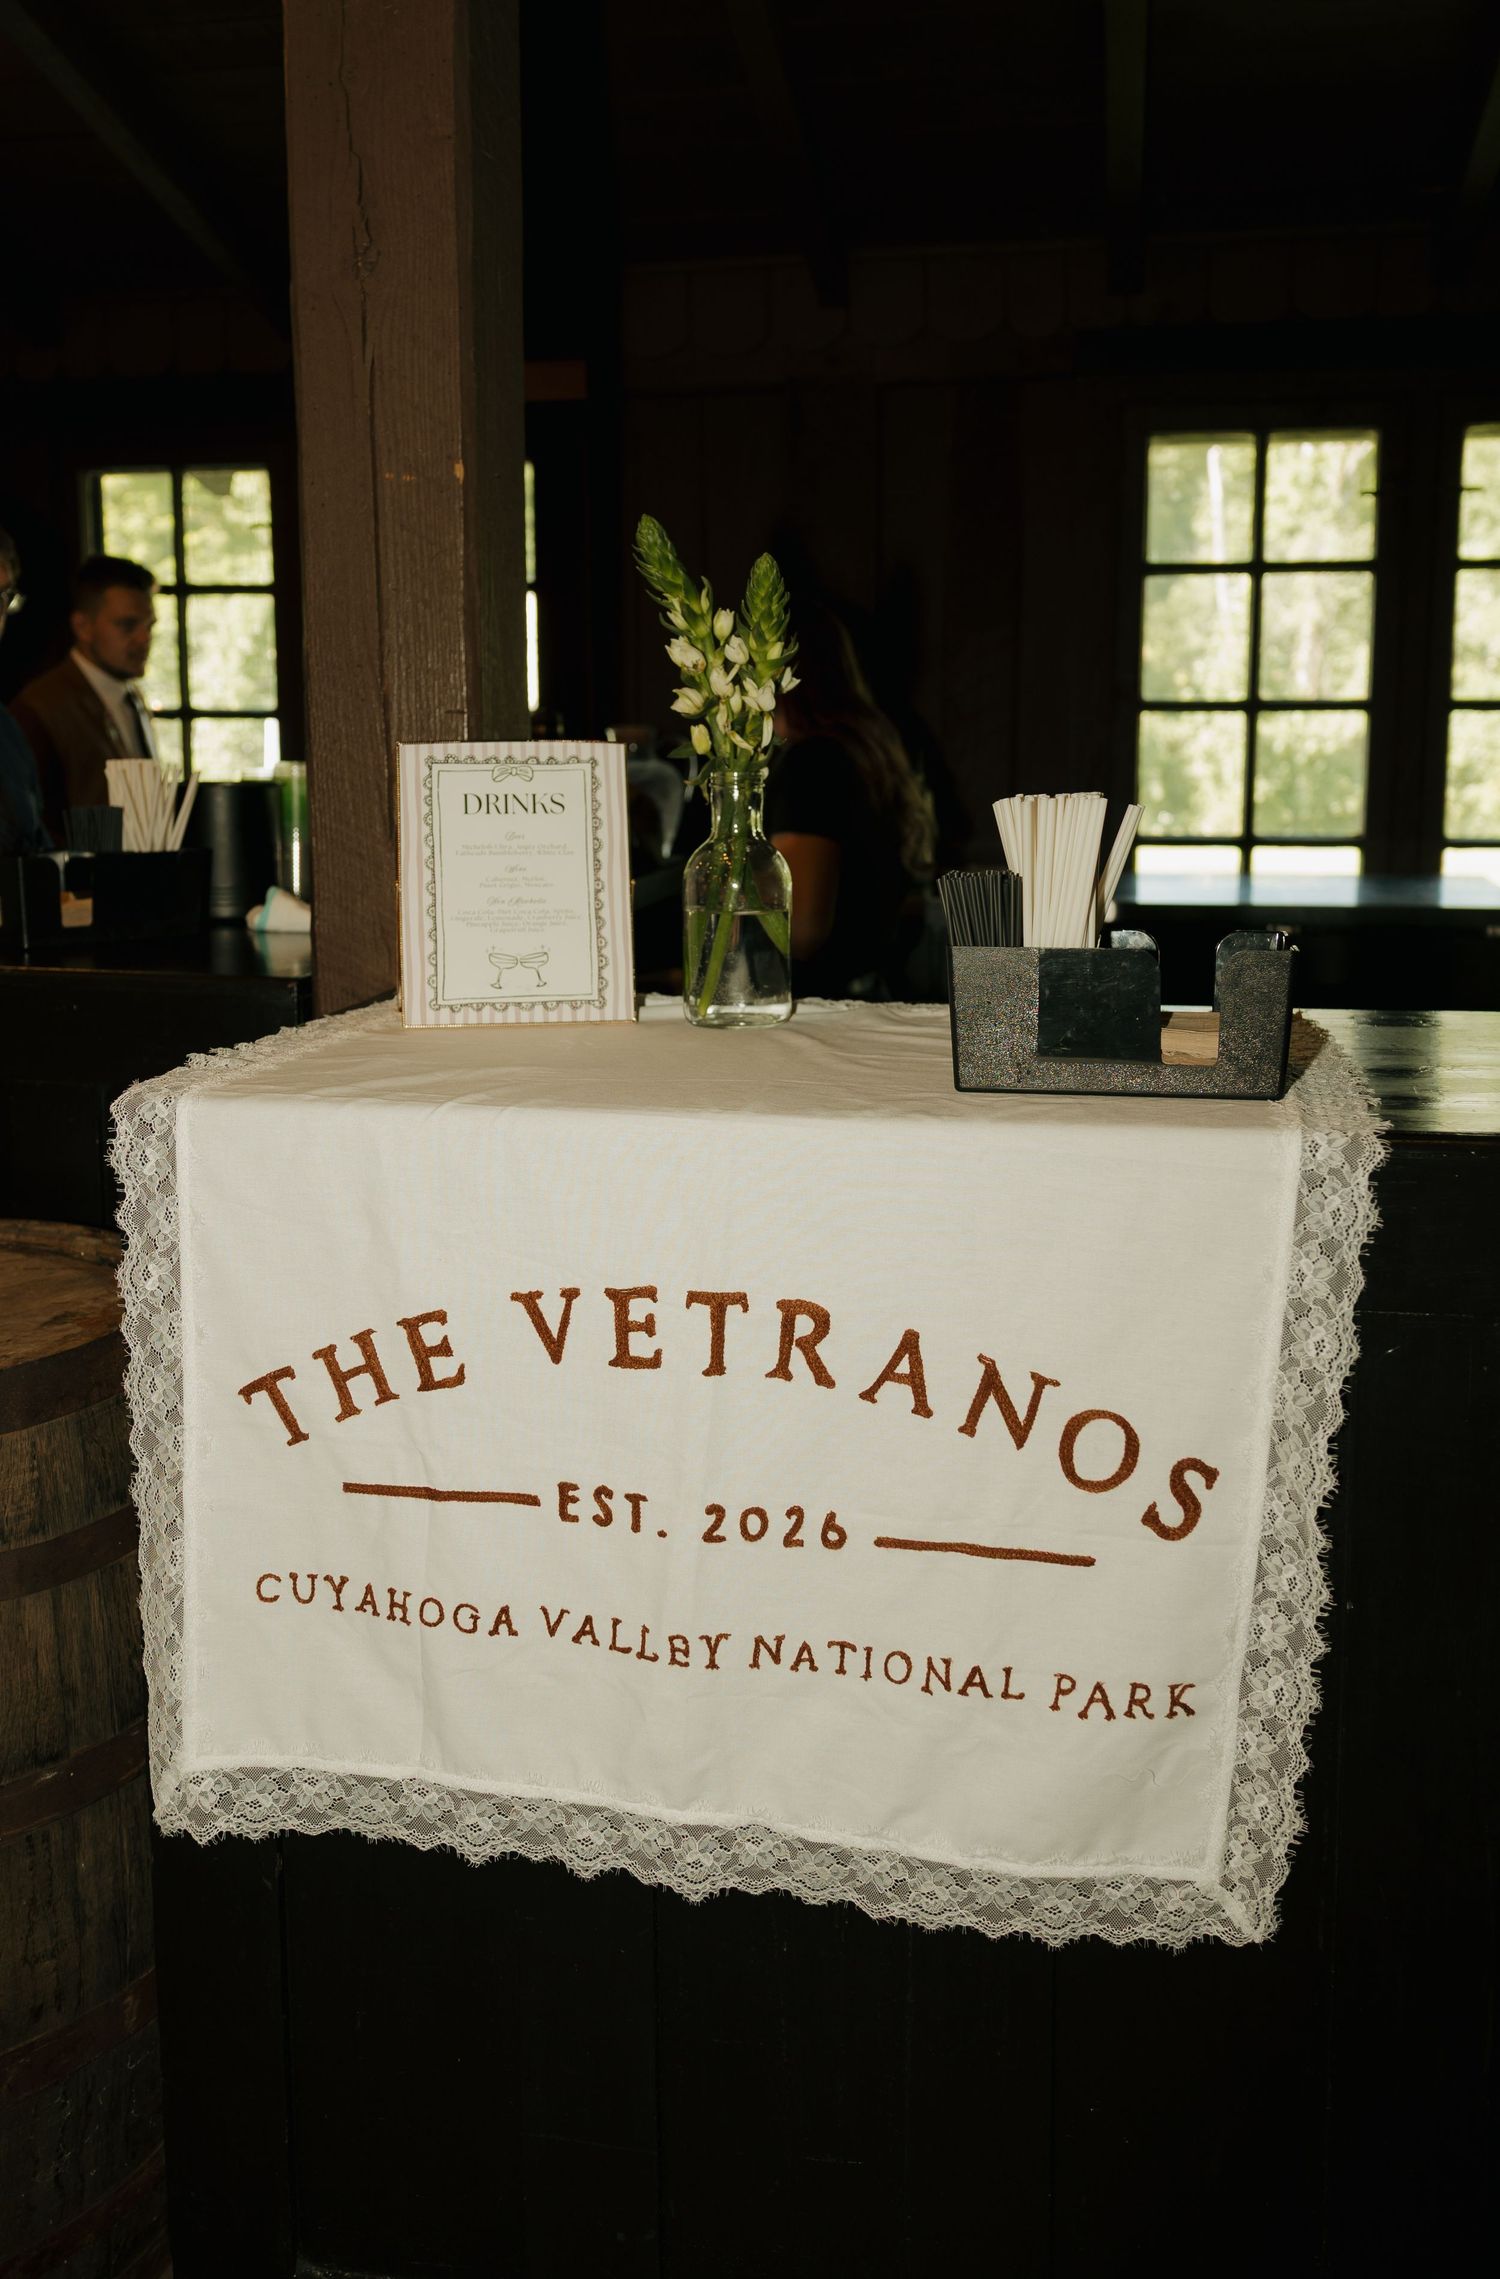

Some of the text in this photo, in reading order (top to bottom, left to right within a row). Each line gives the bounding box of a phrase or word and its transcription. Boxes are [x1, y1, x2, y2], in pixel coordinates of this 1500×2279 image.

[463, 792, 566, 815] DRINKS
[237, 1284, 1220, 1542] THE VETRANOS
[557, 1481, 848, 1551] EST. 2026
[255, 1571, 1197, 1722] CUYAHOGA VALLEY NATIONAL PARK
